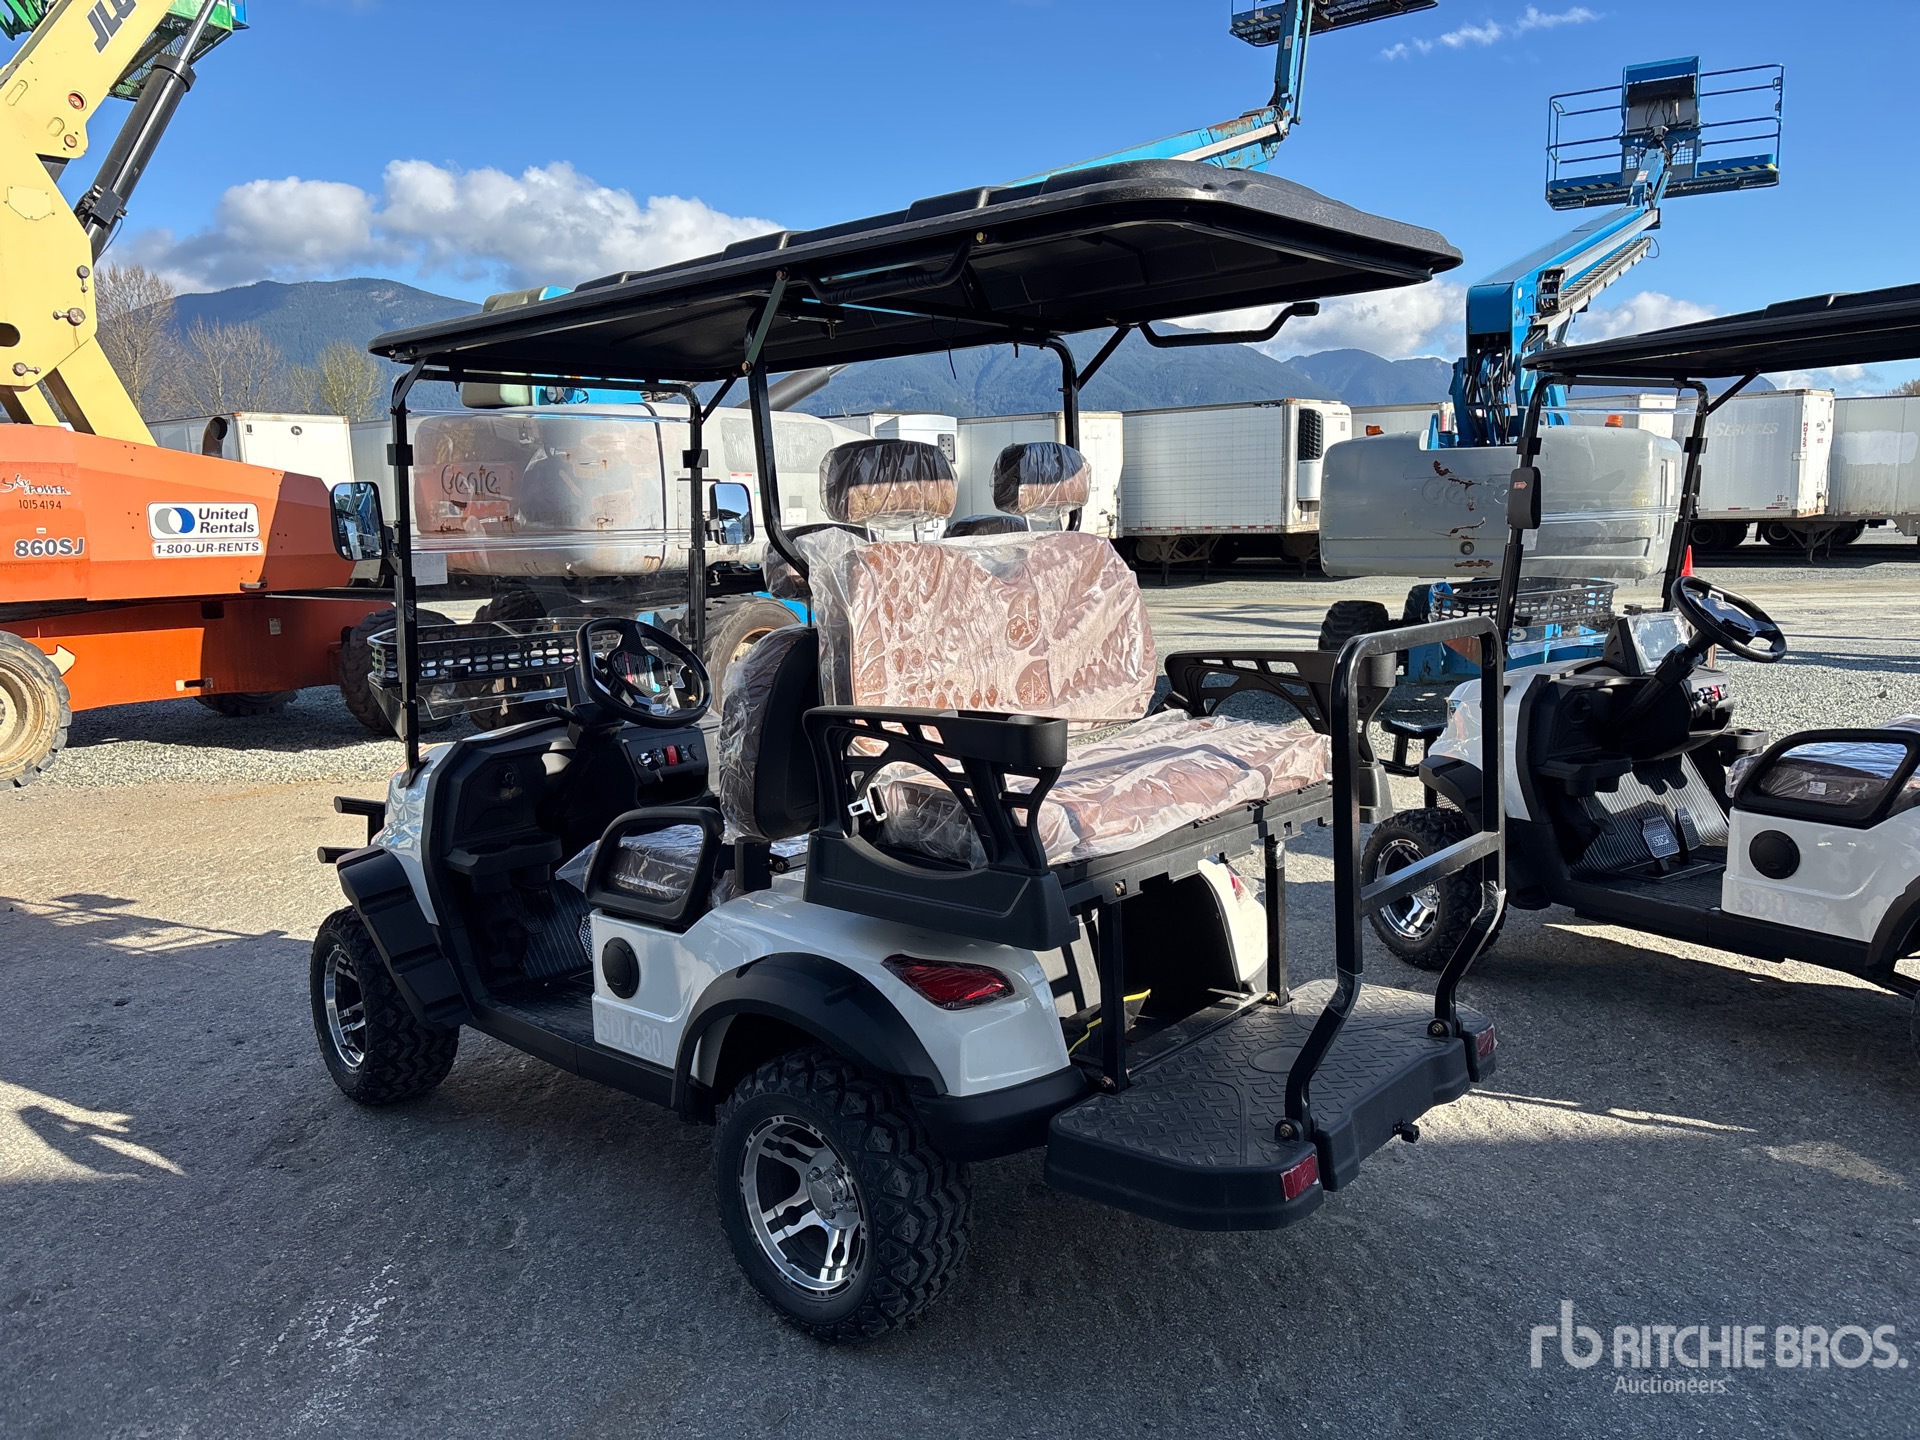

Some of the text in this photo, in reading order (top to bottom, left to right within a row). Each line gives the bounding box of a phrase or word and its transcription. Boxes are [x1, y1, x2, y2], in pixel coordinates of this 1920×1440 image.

[19, 499, 62, 510] 10154194
[198, 507, 248, 520] United
[199, 521, 255, 534] Rentals
[14, 538, 84, 558] 860SJ
[156, 542, 259, 554] 1-800-UR-RENTS
